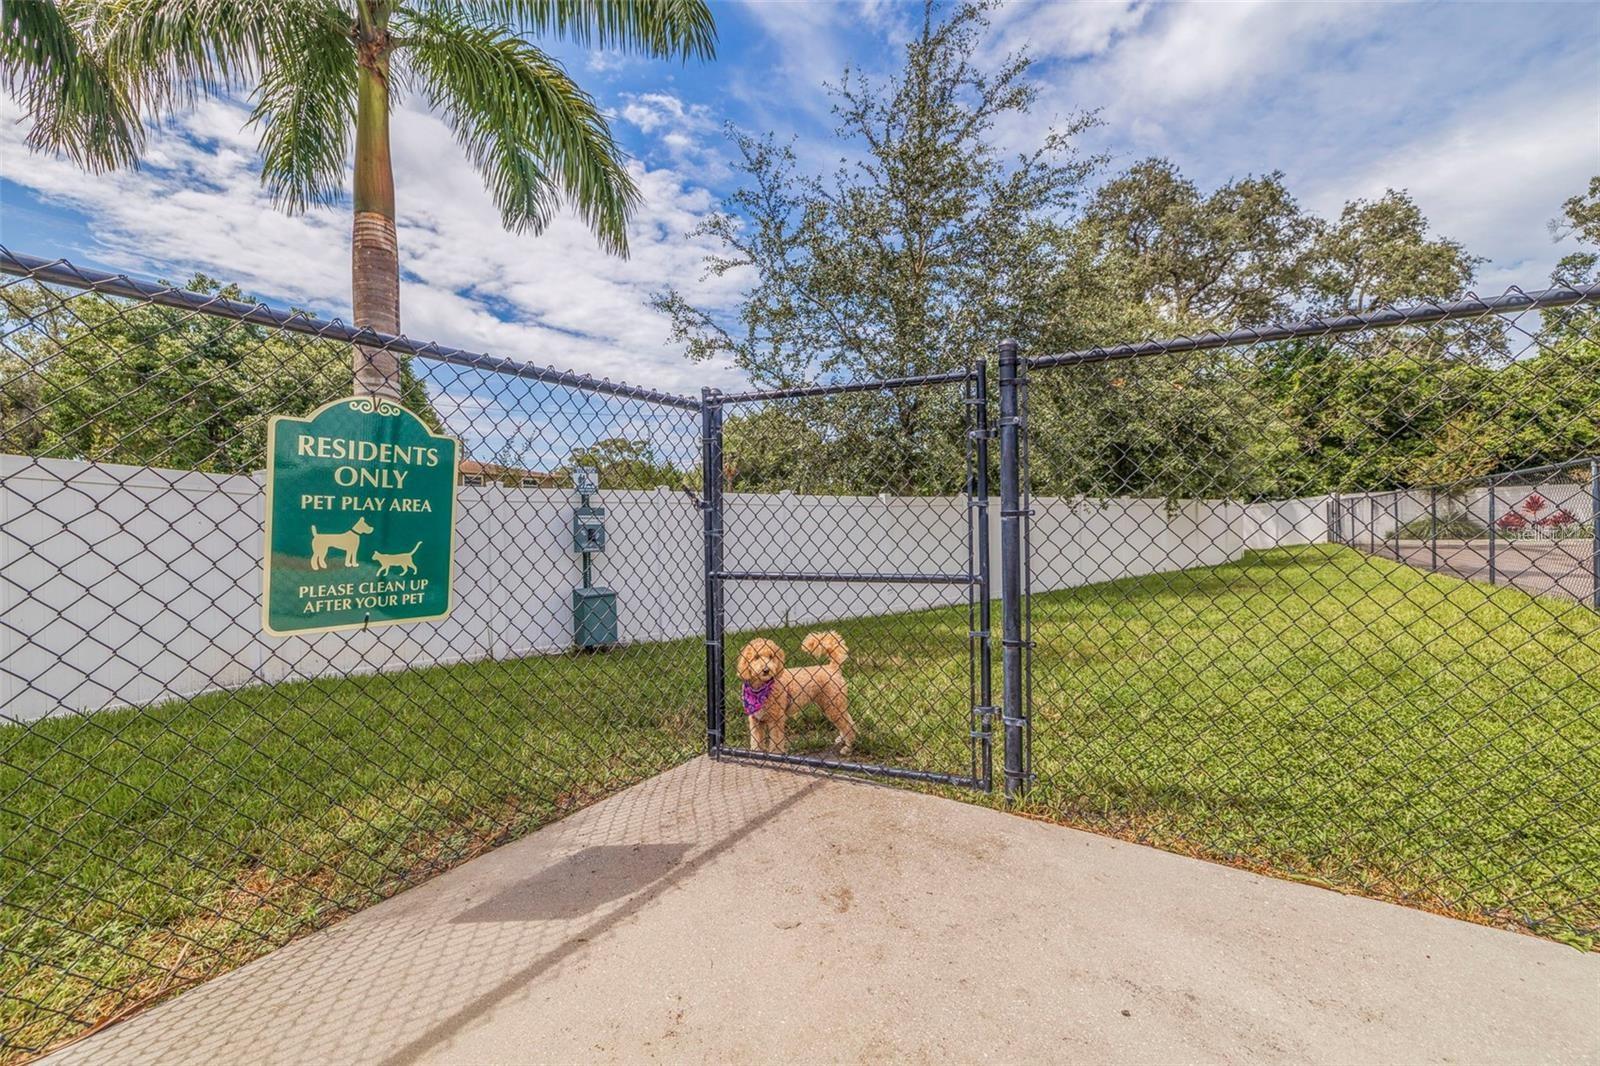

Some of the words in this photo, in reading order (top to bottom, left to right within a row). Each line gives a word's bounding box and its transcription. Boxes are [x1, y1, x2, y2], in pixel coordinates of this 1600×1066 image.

[298, 435, 439, 467] RESIDENTS
[334, 466, 408, 489] ONLY
[301, 495, 335, 510] PET
[341, 496, 385, 512] PLAY
[389, 498, 432, 513] AREA
[299, 583, 354, 599] PLEASE
[358, 580, 405, 594] CLEAN
[410, 579, 429, 591] UP
[303, 598, 351, 613] AFTER
[355, 595, 398, 608] YOUR
[402, 593, 425, 605] PET
